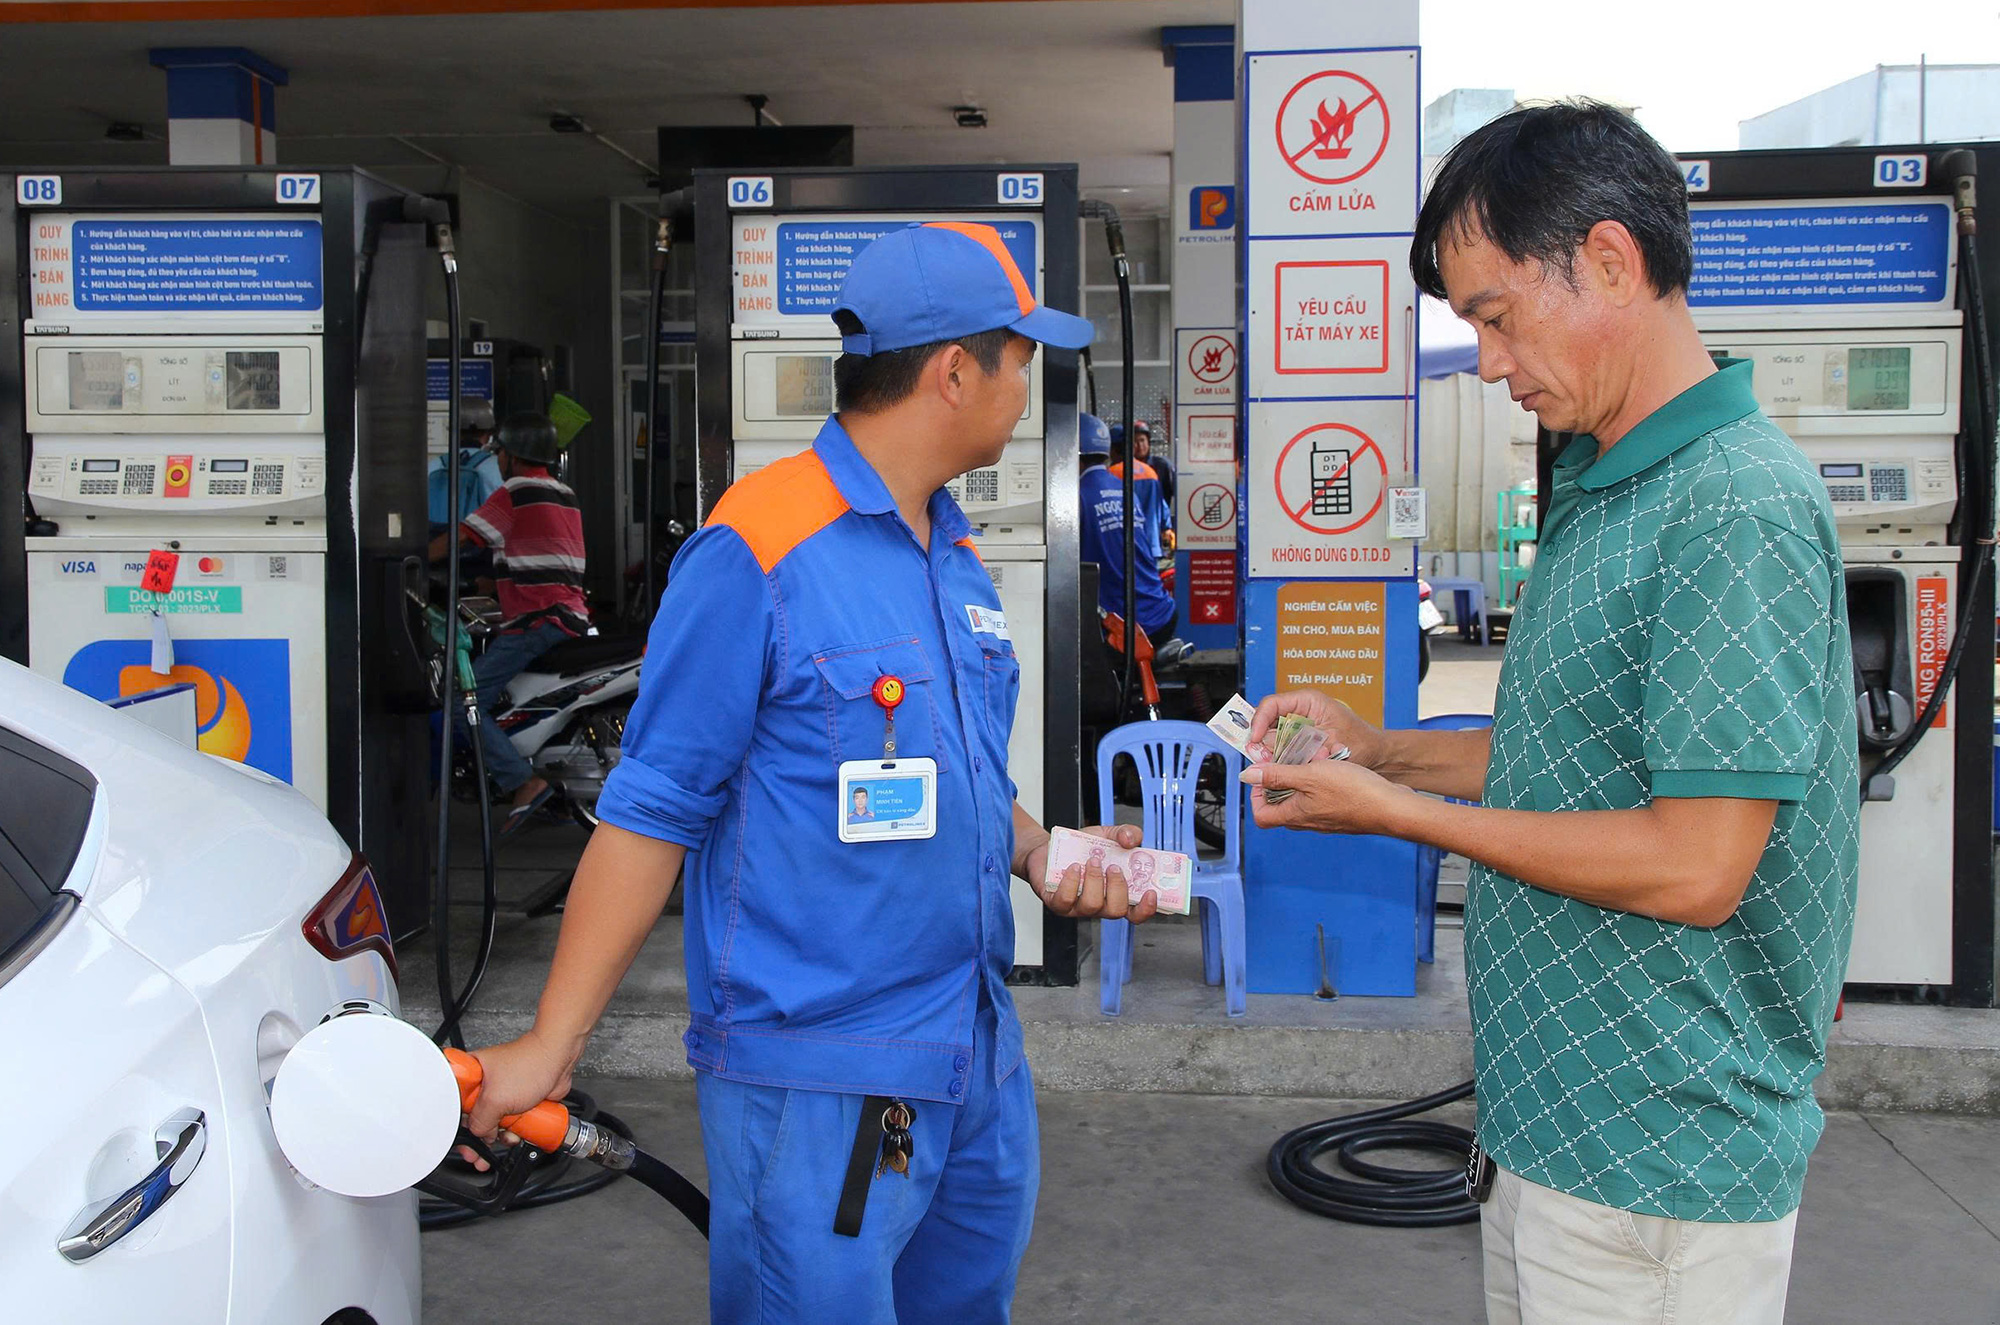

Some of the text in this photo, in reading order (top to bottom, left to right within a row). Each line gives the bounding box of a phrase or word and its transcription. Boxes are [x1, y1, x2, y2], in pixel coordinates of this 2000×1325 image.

[1879, 159, 1921, 182] 03
[23, 179, 56, 200] 08
[281, 178, 315, 199] 07
[732, 181, 769, 203] 06
[1002, 177, 1039, 199] 05
[1289, 188, 1376, 212] CẤM LỬA
[40, 226, 62, 239] QUY
[743, 228, 766, 242] QUY
[34, 245, 69, 261] TRÌNH
[737, 250, 773, 267] TRÌNH
[785, 258, 792, 266] 2.
[40, 269, 64, 284] BÁN
[743, 272, 767, 288] BÁN
[786, 271, 792, 279] 3.
[37, 290, 69, 306] HÀNG
[739, 296, 772, 313] HÀNG
[786, 297, 792, 305] 5.
[1298, 294, 1366, 316] YÊU CẦU
[744, 331, 778, 339] TATSUNO
[1285, 317, 1379, 341] TẮT MÁY XE
[476, 343, 490, 353] 19
[1272, 545, 1391, 563] KHÔNG DÙNG Đ.T.D.Đ
[61, 561, 97, 573] VISA
[129, 590, 151, 602] DO
[1284, 599, 1378, 614] NGHIÊM CẤM VIỆC
[1283, 623, 1380, 636] XIN CHO, MUA BÁN
[1920, 589, 1935, 664] RON95-III
[1283, 647, 1378, 659] HÓA ĐƠN XĂNG DẦU
[1287, 673, 1373, 686] TRÁI PHÁP LUẬT
